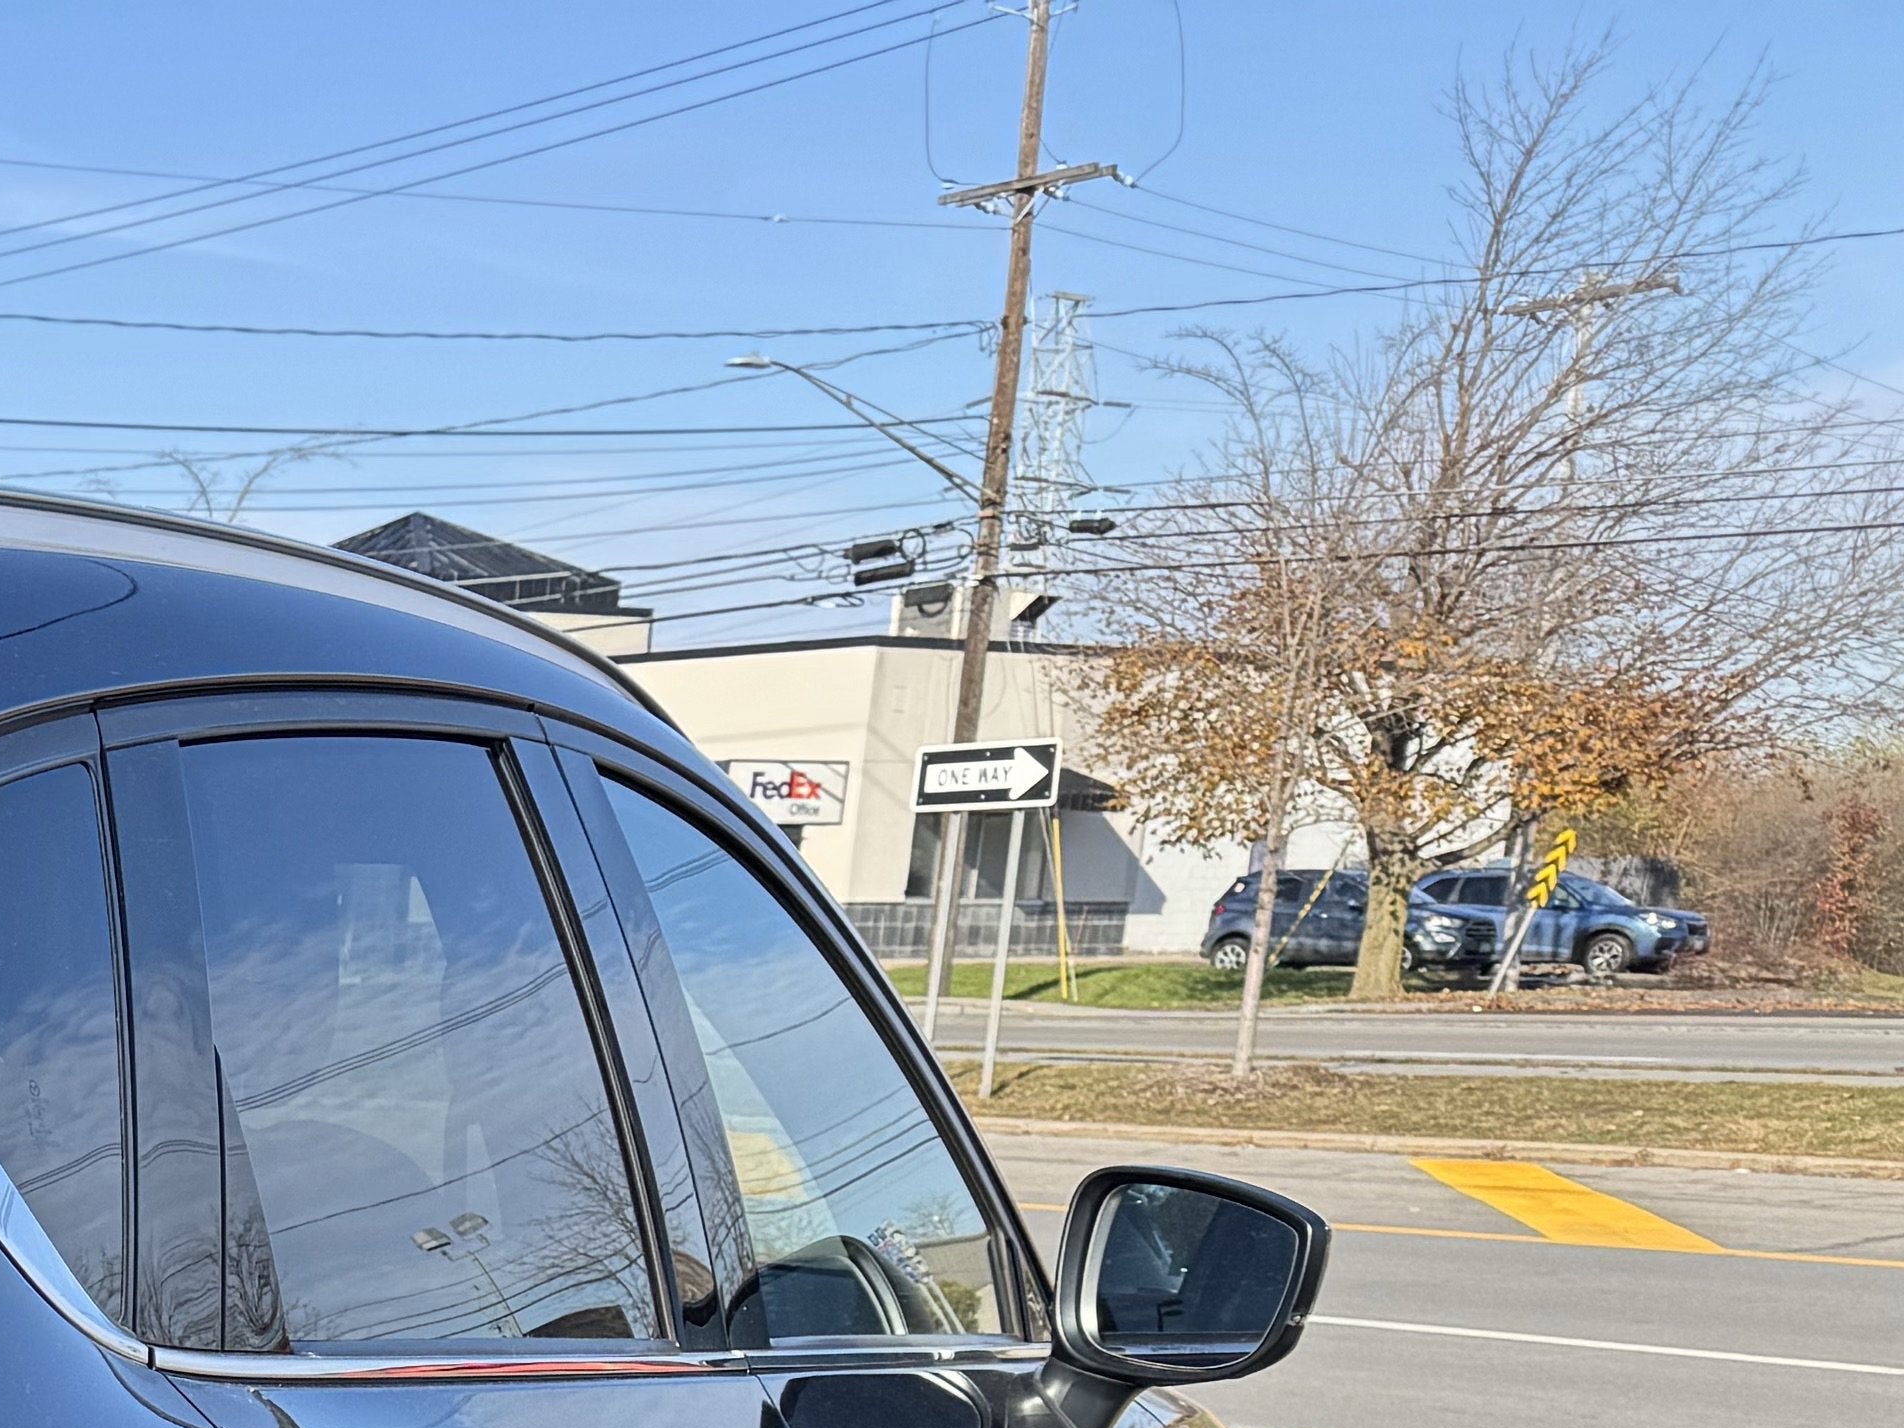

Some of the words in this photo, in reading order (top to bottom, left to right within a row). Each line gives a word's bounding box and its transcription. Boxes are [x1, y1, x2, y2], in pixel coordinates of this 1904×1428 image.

[750, 771, 822, 799] FedEx
[938, 768, 971, 786] ONE
[979, 766, 1013, 784] WAY
